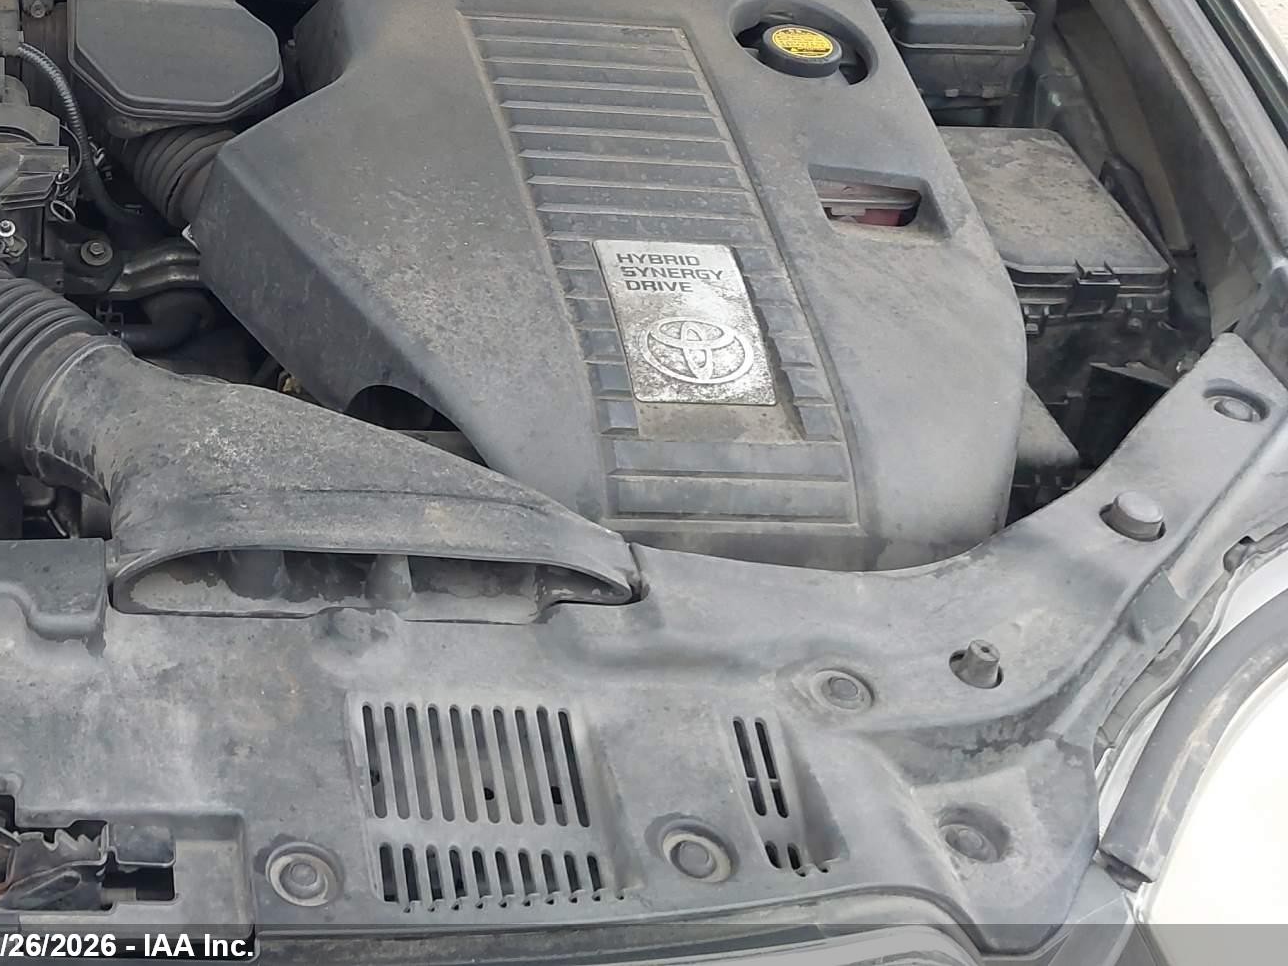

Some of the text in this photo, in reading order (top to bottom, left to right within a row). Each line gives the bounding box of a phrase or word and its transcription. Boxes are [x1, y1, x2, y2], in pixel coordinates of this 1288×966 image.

[616, 253, 700, 266] HYBRID
[620, 266, 723, 280] SYNERGY
[625, 280, 693, 292] DRIVE
